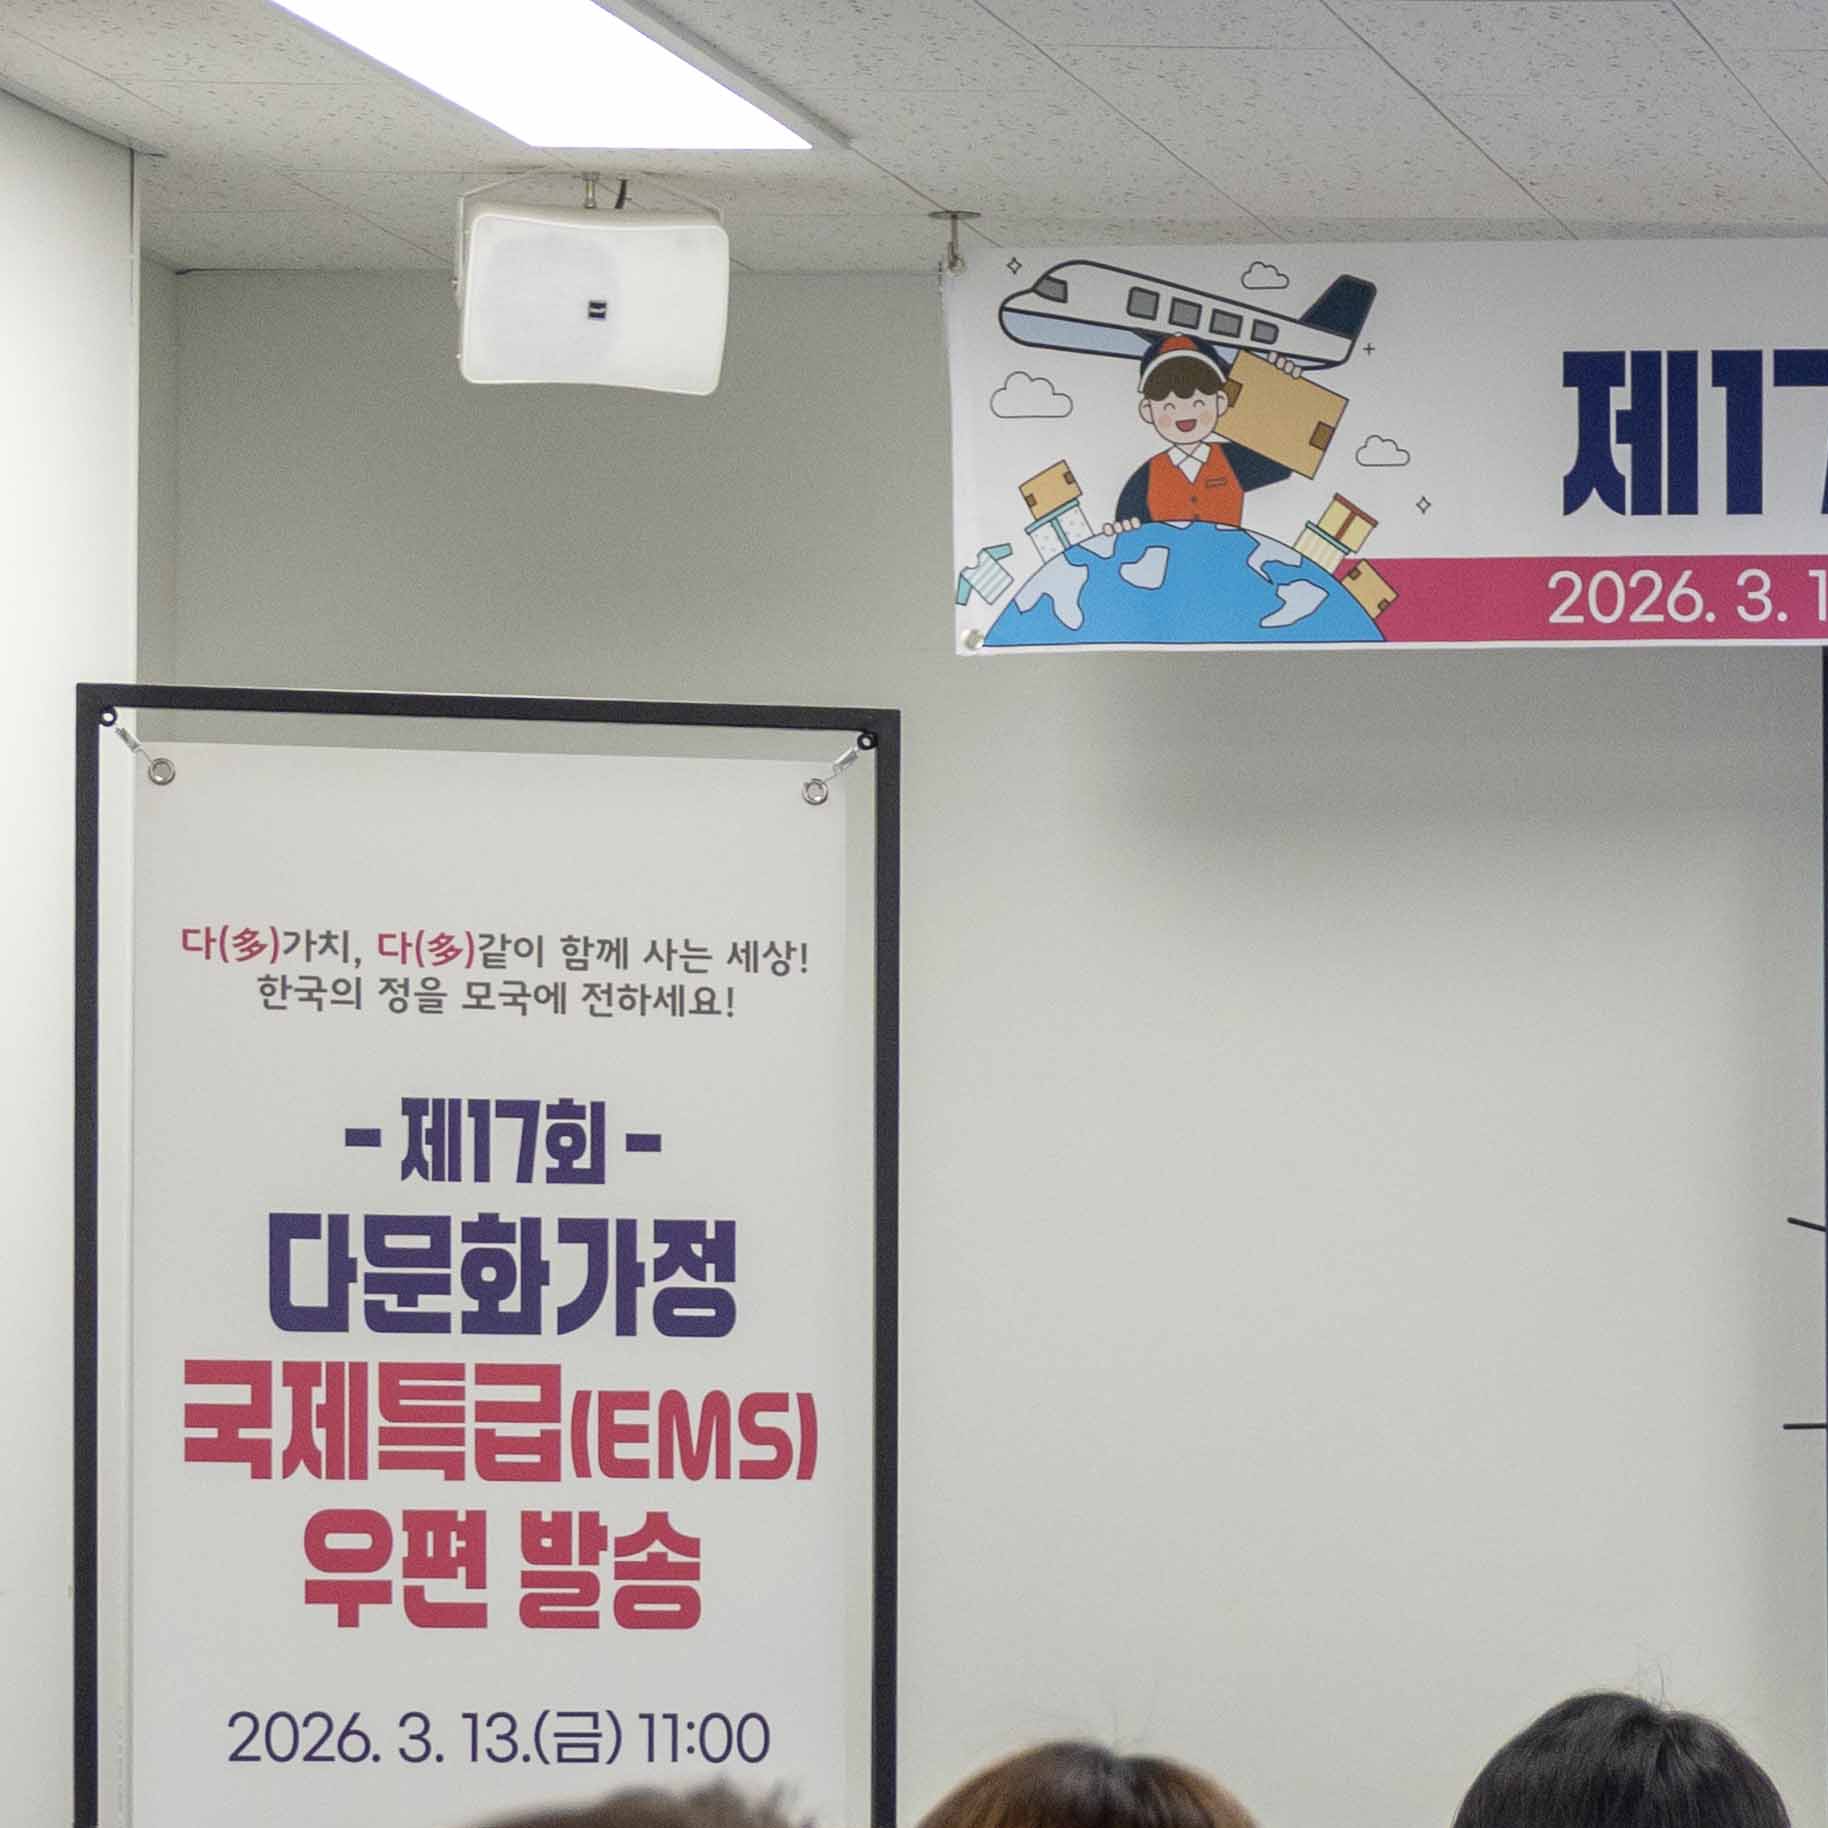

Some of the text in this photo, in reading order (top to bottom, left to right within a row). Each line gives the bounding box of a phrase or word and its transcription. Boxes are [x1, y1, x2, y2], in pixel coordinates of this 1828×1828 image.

[1548, 568, 1715, 624] 2026.
[1737, 568, 1787, 624] 3.
[182, 926, 809, 976] 다(多)가치, 다(多)같이 함께 사는 세상!
[257, 973, 735, 1019] 한국의 정을 모국에 전하세요!
[400, 1096, 606, 1185] 제17회
[268, 1212, 737, 1338] 다문화가정
[183, 1359, 818, 1482] 국제특급(EMS)
[303, 1508, 702, 1630] 우편 발송
[227, 1708, 771, 1766] 2026. 3. 13.(금) 11:00
